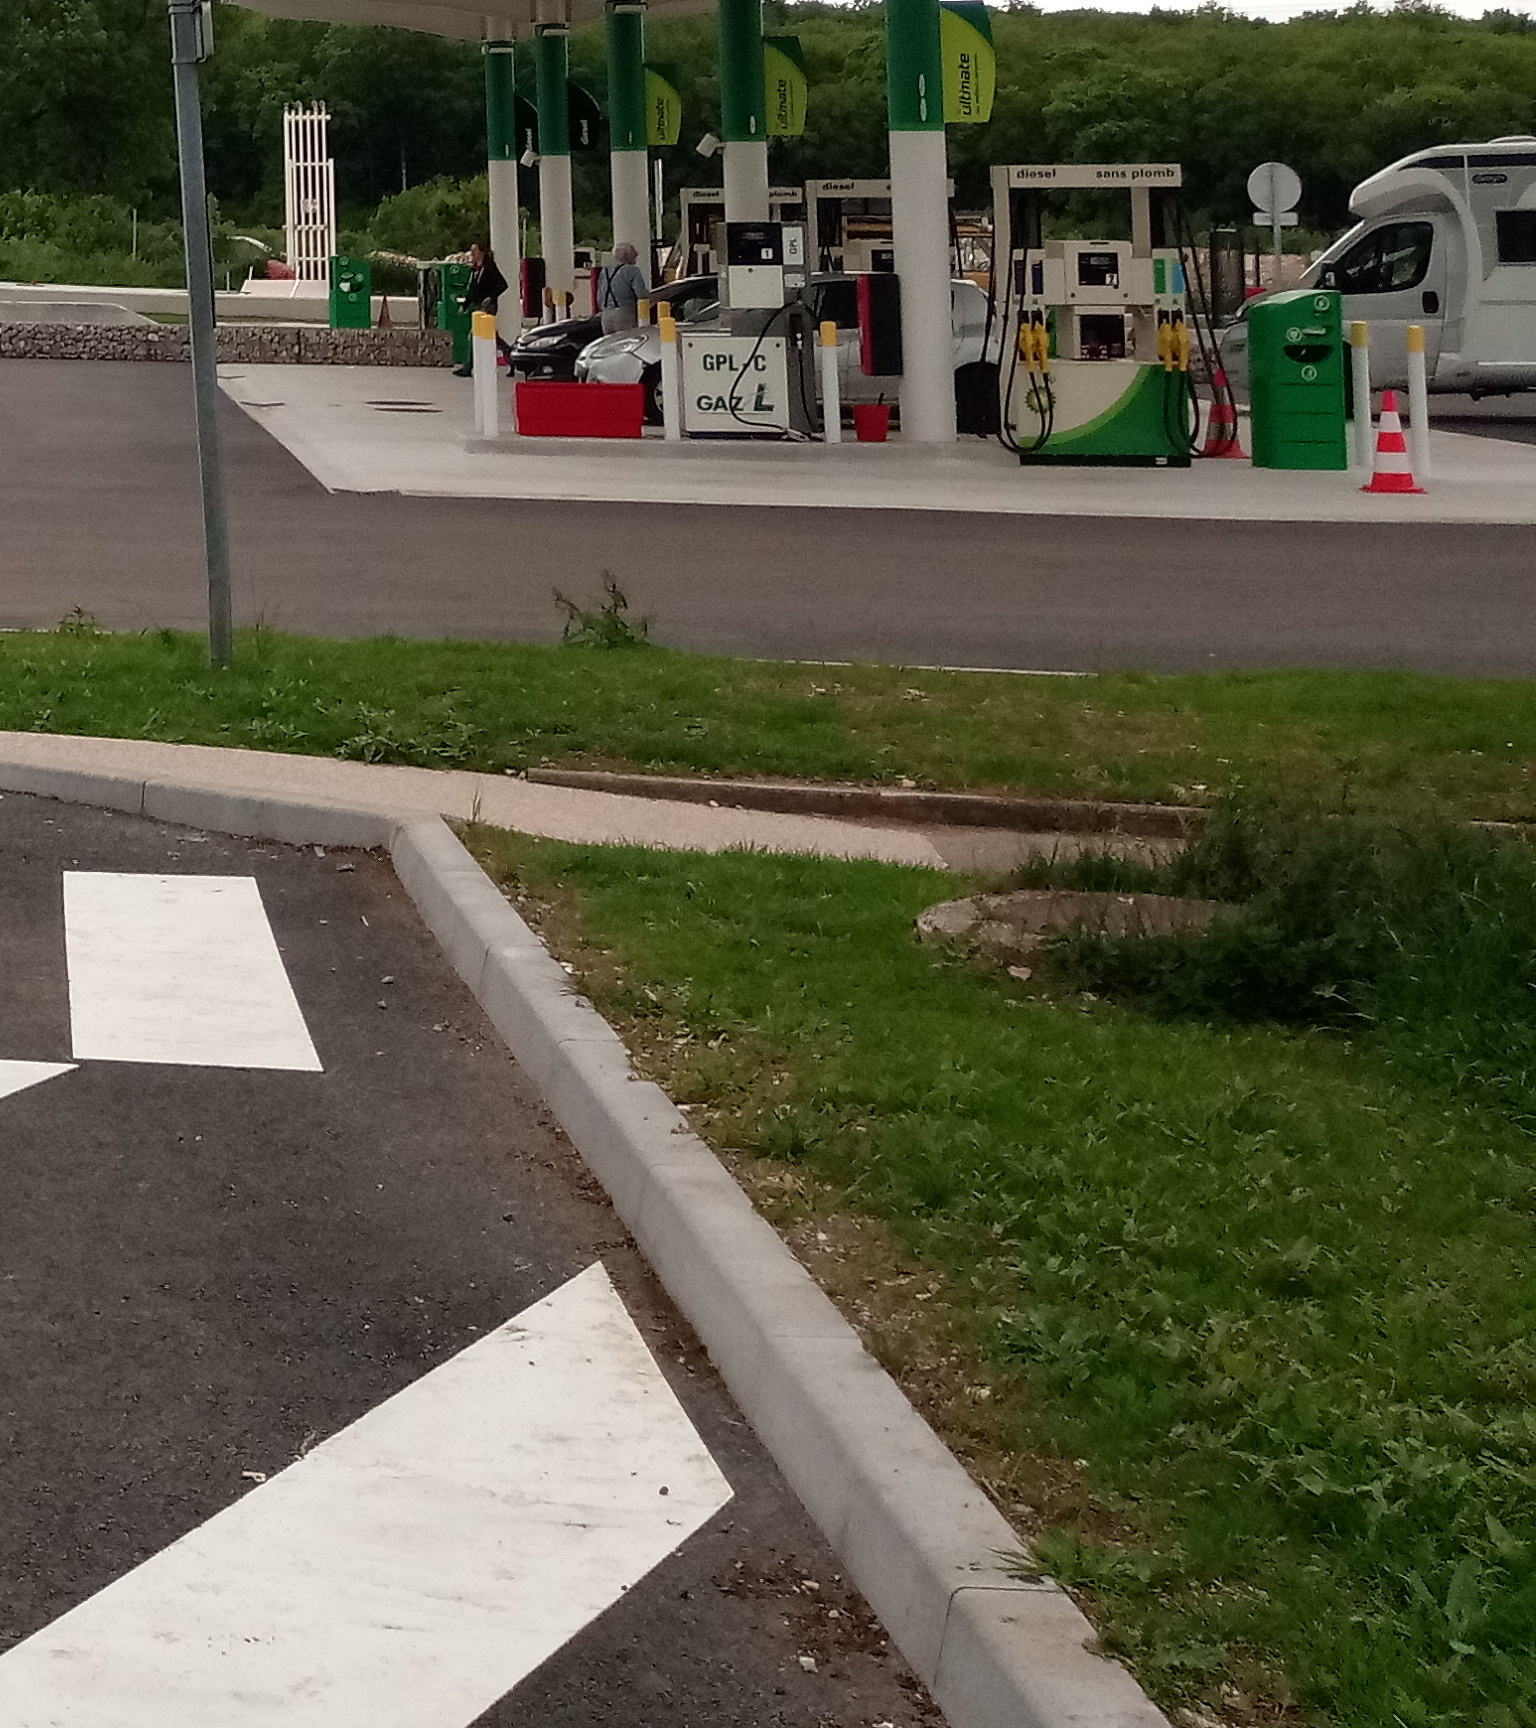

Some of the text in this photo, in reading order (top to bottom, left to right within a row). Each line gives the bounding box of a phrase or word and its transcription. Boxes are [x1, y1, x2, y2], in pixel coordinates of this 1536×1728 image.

[958, 52, 972, 116] ultimate
[1016, 168, 1175, 180] diesel sans plomb
[822, 182, 855, 191] diesel
[696, 394, 745, 412] GAZ
